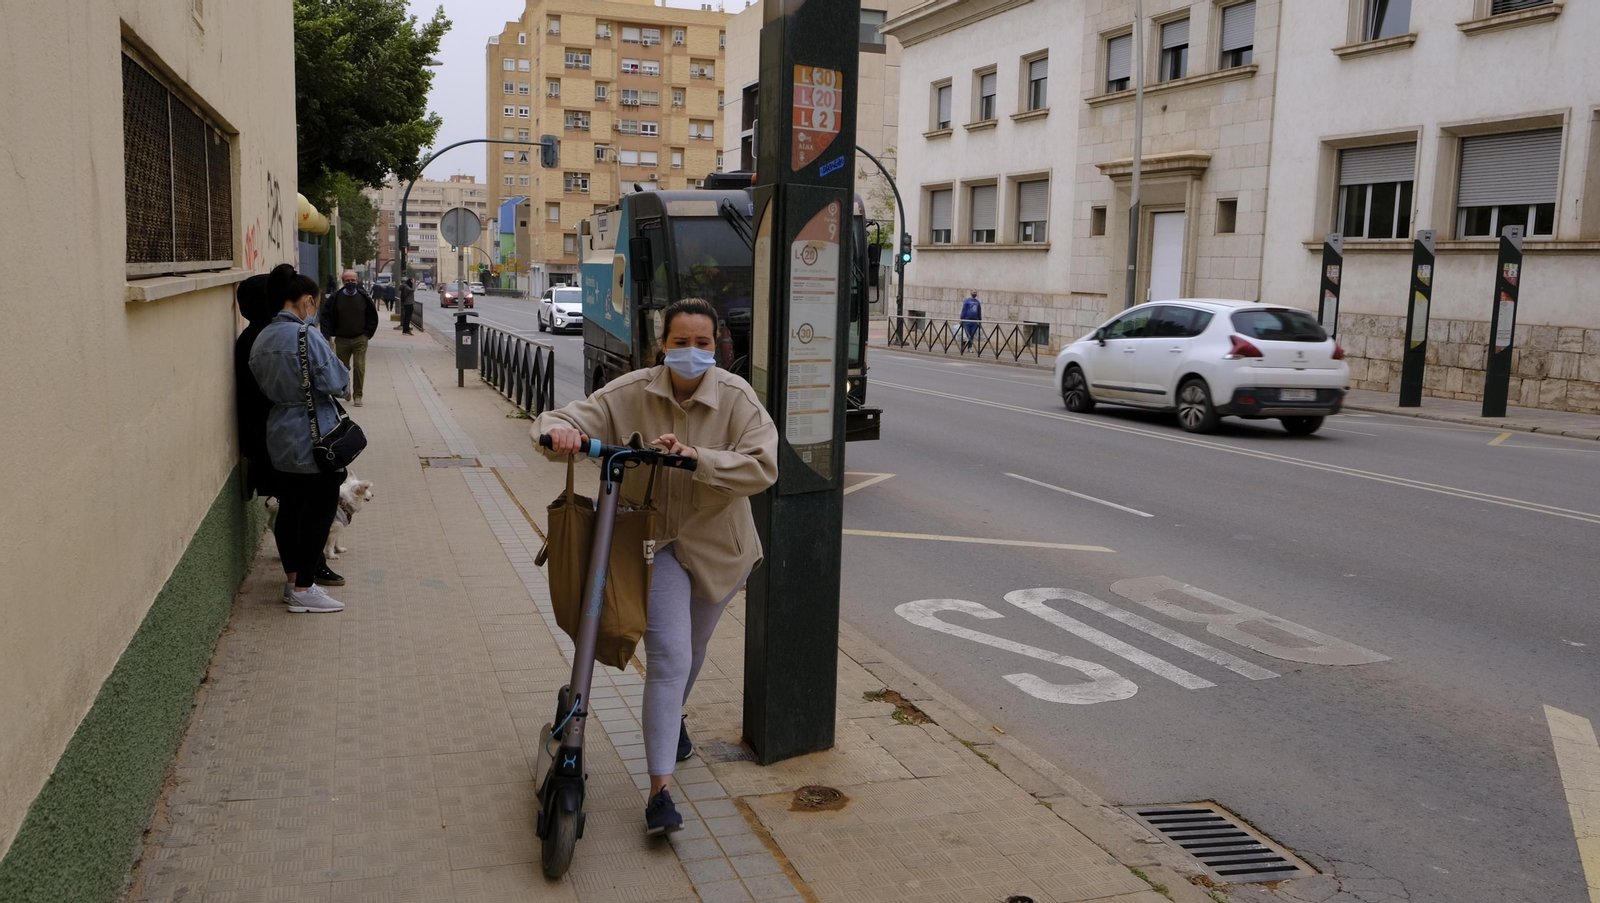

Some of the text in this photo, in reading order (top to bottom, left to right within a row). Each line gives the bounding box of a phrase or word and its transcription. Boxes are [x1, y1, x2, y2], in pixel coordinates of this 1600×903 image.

[801, 68, 833, 87] L 30
[801, 90, 832, 108] L 20
[801, 111, 828, 129] L 2
[828, 223, 837, 241] 9
[794, 249, 815, 260] L 20
[791, 328, 811, 339] L 30
[299, 336, 307, 357] LOLA
[306, 391, 314, 412] LOLA
[586, 566, 605, 617] bongo
[894, 576, 1393, 705] BUS
